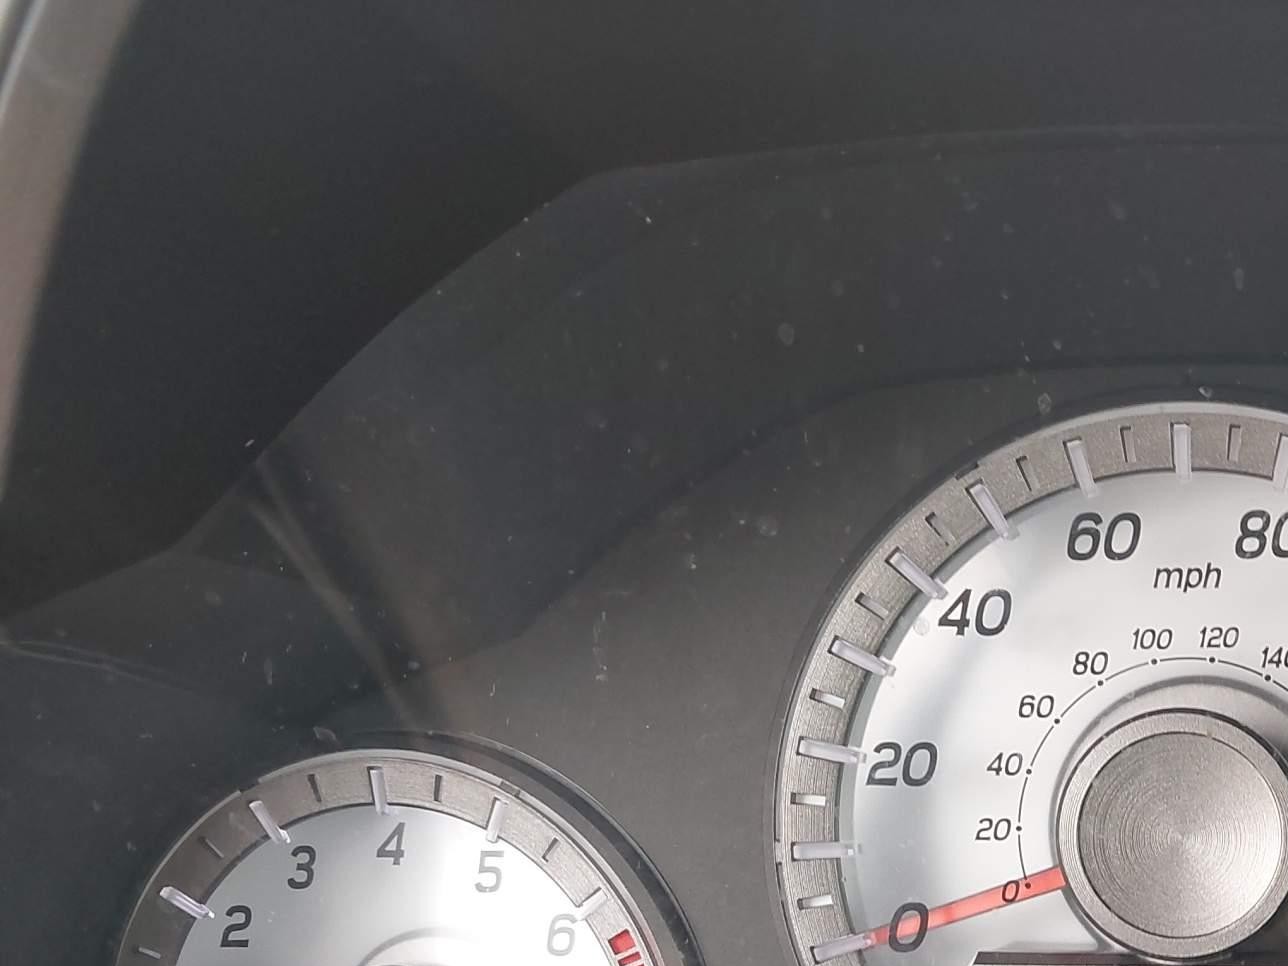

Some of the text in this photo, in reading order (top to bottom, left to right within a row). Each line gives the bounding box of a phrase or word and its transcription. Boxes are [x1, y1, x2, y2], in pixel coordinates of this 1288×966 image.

[1067, 512, 1142, 561] 60
[1153, 563, 1222, 593] mph
[937, 589, 1014, 637] 40
[1132, 628, 1173, 650] 100
[1199, 626, 1239, 649] 120
[1072, 652, 1109, 676] 80
[1018, 695, 1055, 720] 60
[866, 741, 938, 787] 20
[986, 753, 1023, 777] 40
[375, 822, 406, 866] 4
[975, 818, 1012, 841] 20
[286, 845, 317, 889] 3
[474, 850, 504, 893] 5
[1001, 880, 1020, 903] 0
[220, 905, 252, 948] 2
[546, 913, 577, 957] 6
[888, 901, 928, 952] 0
